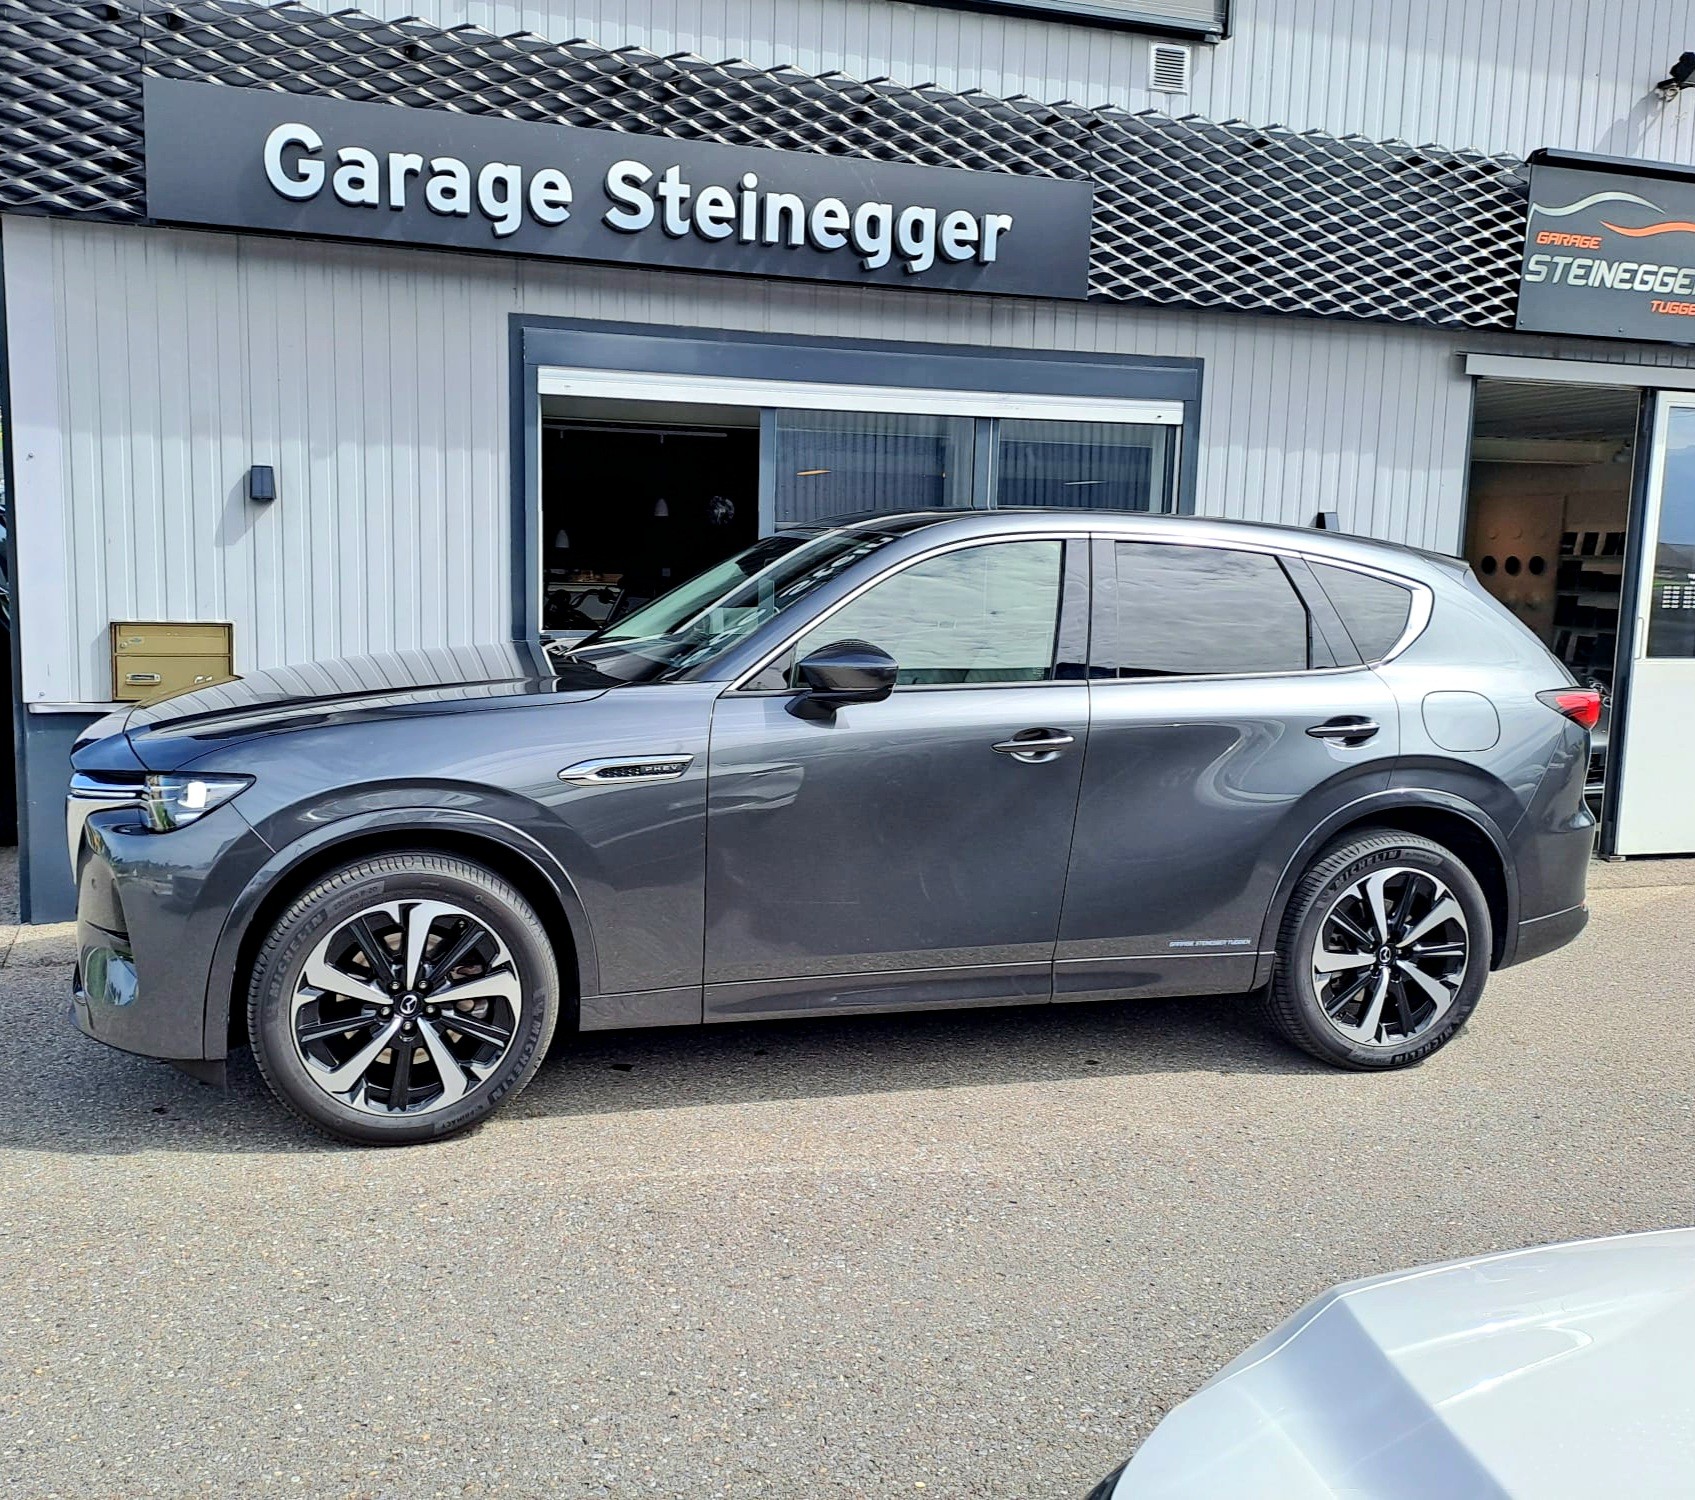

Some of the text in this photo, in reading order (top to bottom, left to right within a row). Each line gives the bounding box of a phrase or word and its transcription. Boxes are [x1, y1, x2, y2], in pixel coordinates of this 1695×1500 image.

[264, 122, 1012, 274] Garage Steinegger
[1535, 231, 1602, 249] GARAGE
[1524, 254, 1695, 295] STEINEGGE
[645, 764, 678, 772] PHEV
[1334, 850, 1399, 889] MICHELIN
